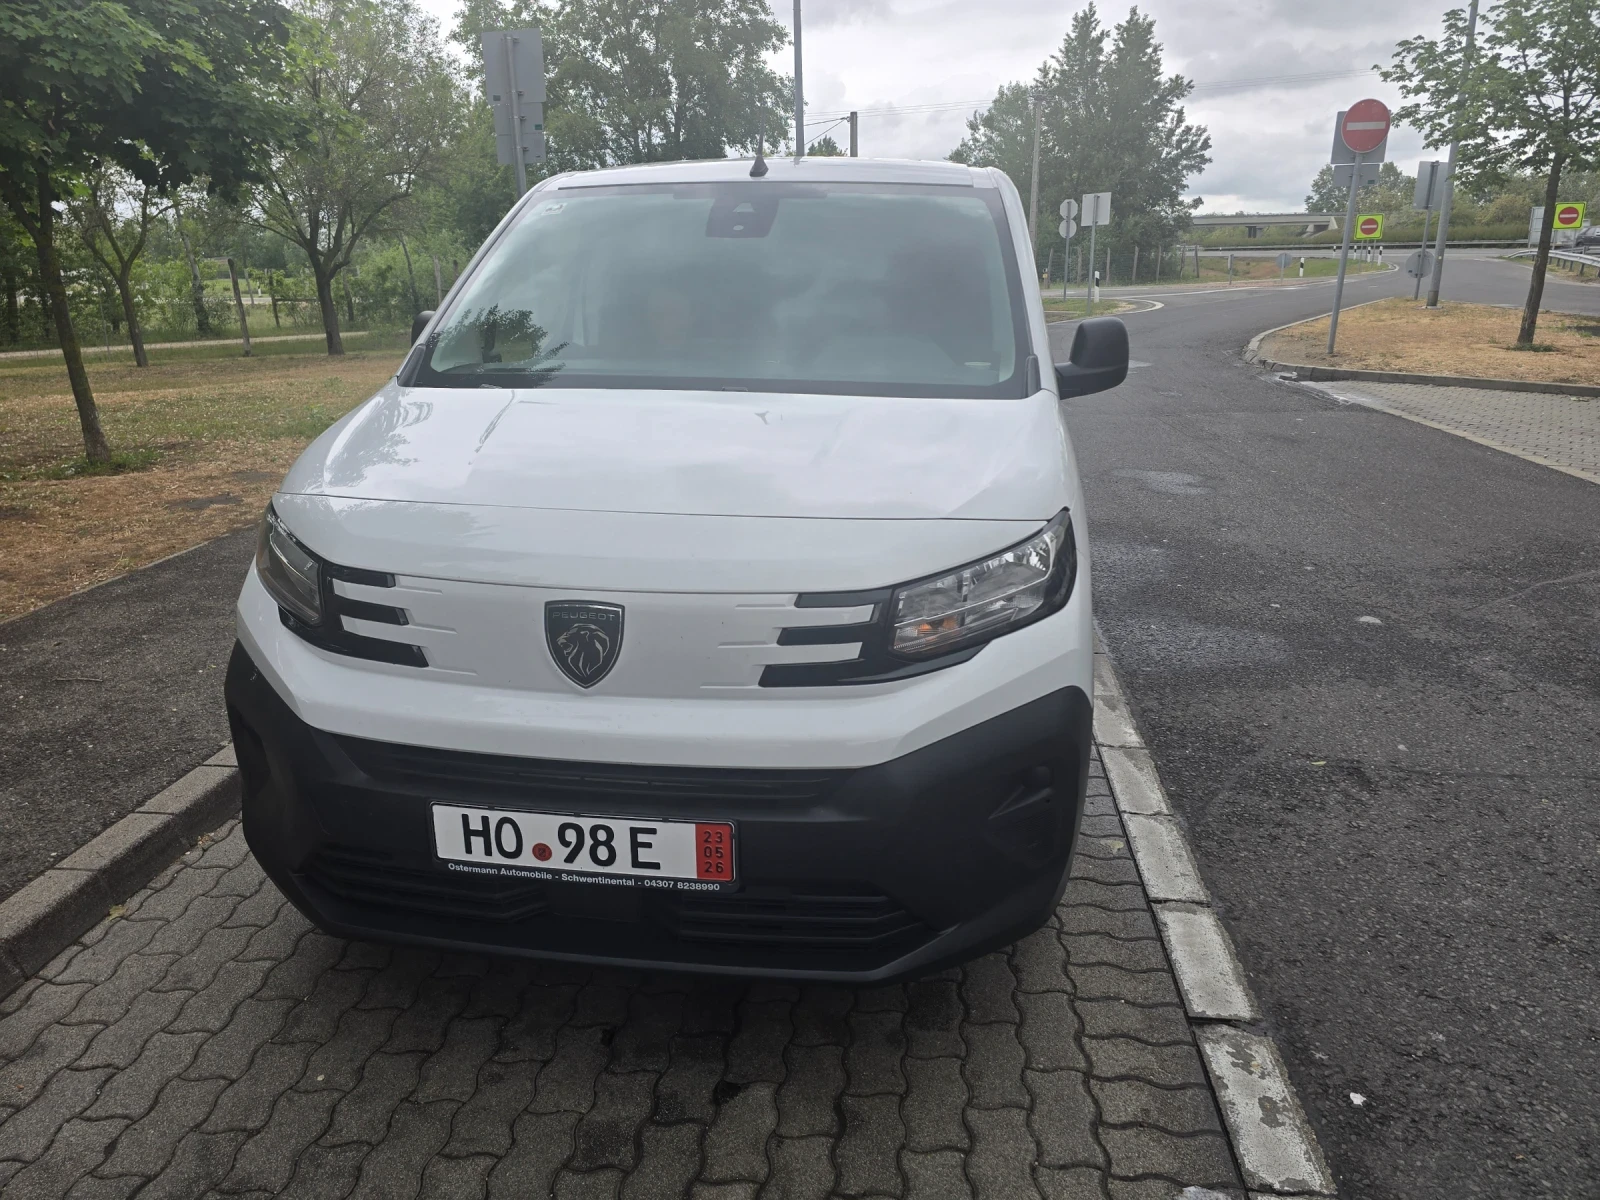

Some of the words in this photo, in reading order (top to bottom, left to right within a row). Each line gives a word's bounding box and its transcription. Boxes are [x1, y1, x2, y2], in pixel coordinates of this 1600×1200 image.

[552, 611, 615, 621] PEUGEOT
[461, 813, 523, 860] HO
[557, 822, 617, 867] 98
[629, 826, 661, 870] E
[703, 830, 724, 844] 23
[703, 845, 725, 859] 05
[704, 860, 725, 874] 26
[448, 862, 498, 875] Ostermann
[500, 867, 552, 880] Automobile
[561, 873, 635, 887] Schwentinental
[644, 879, 674, 889] 04307
[677, 881, 720, 891] 8238990
